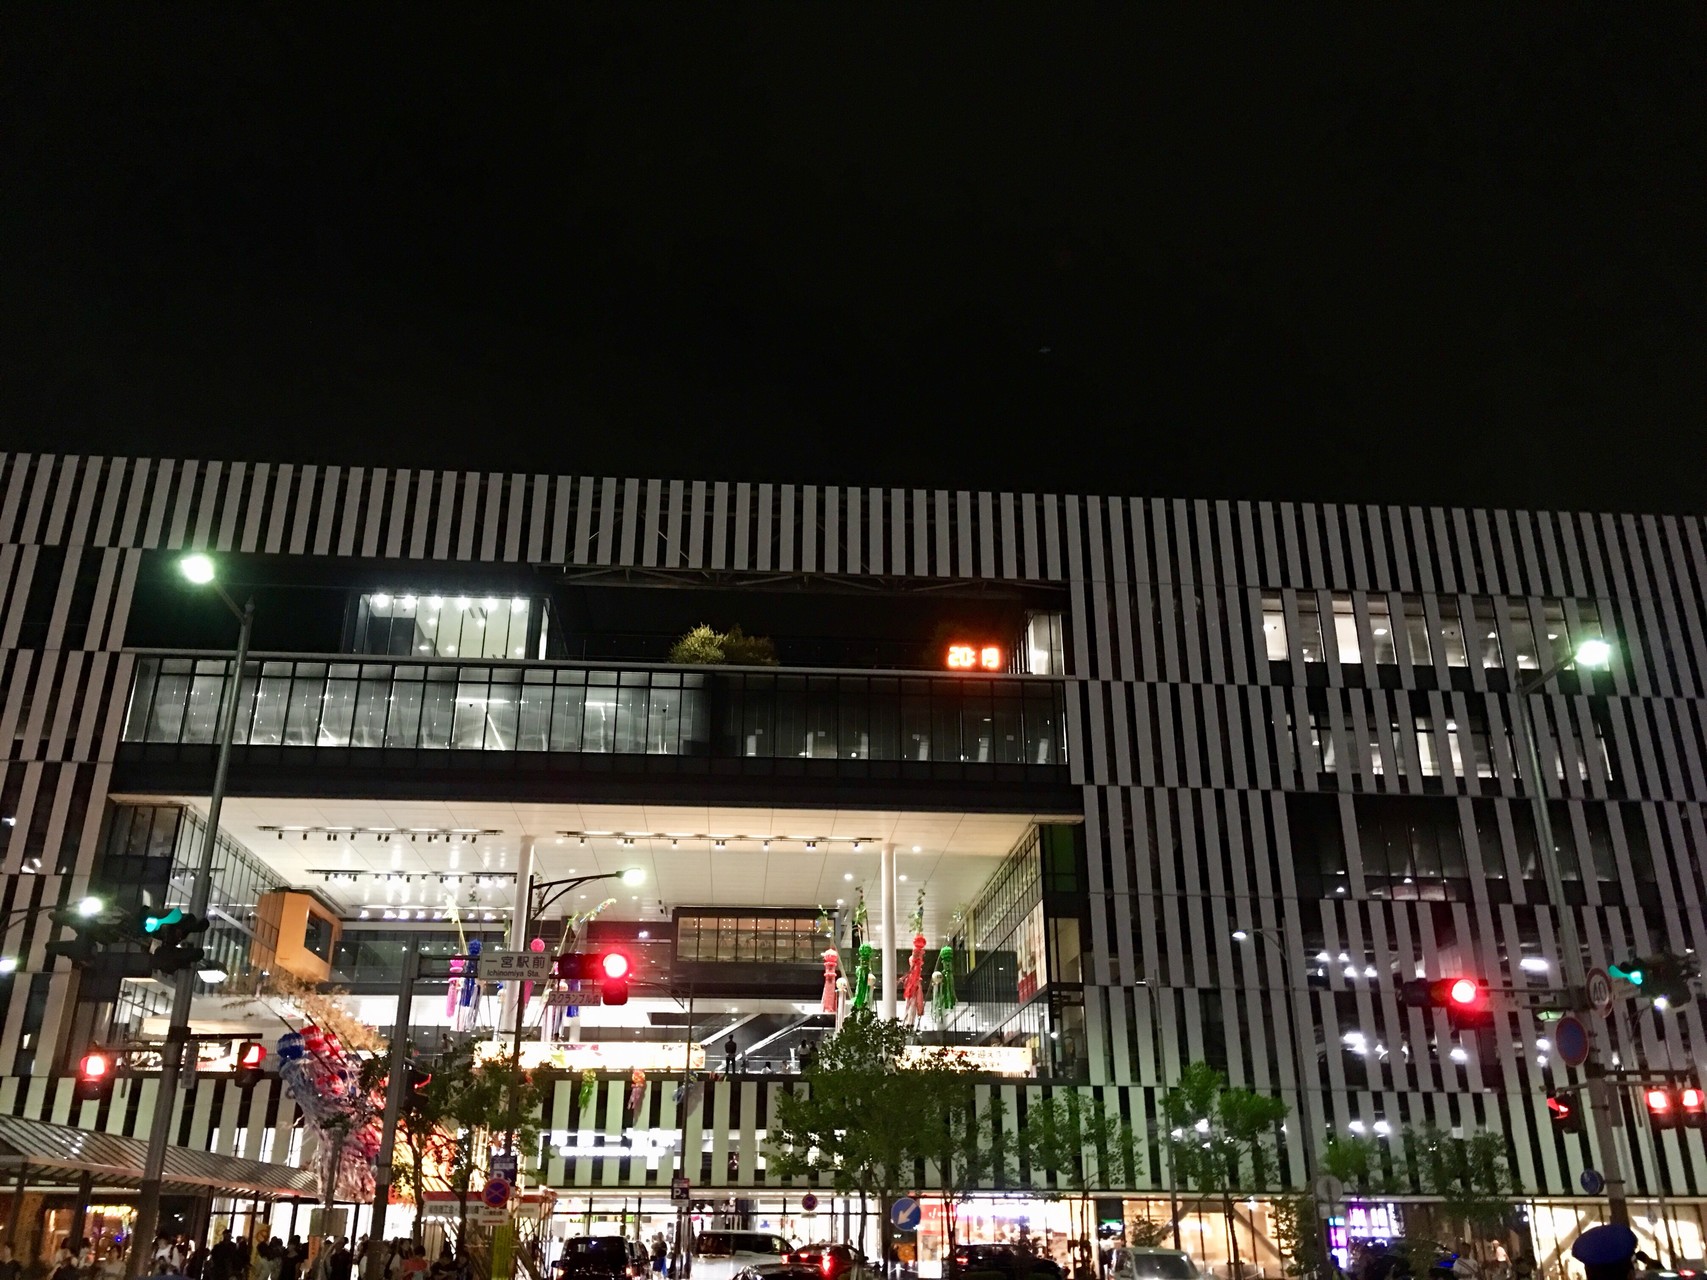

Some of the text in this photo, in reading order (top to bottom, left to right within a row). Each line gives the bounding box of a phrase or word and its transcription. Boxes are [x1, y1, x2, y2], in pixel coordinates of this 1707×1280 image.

[485, 955, 545, 969] 一宮駅前
[487, 969, 541, 978] Ichinomiya Sta.
[1593, 980, 1607, 1002] 40
[550, 993, 600, 1004] スクランブル式
[673, 1188, 682, 1199] P
